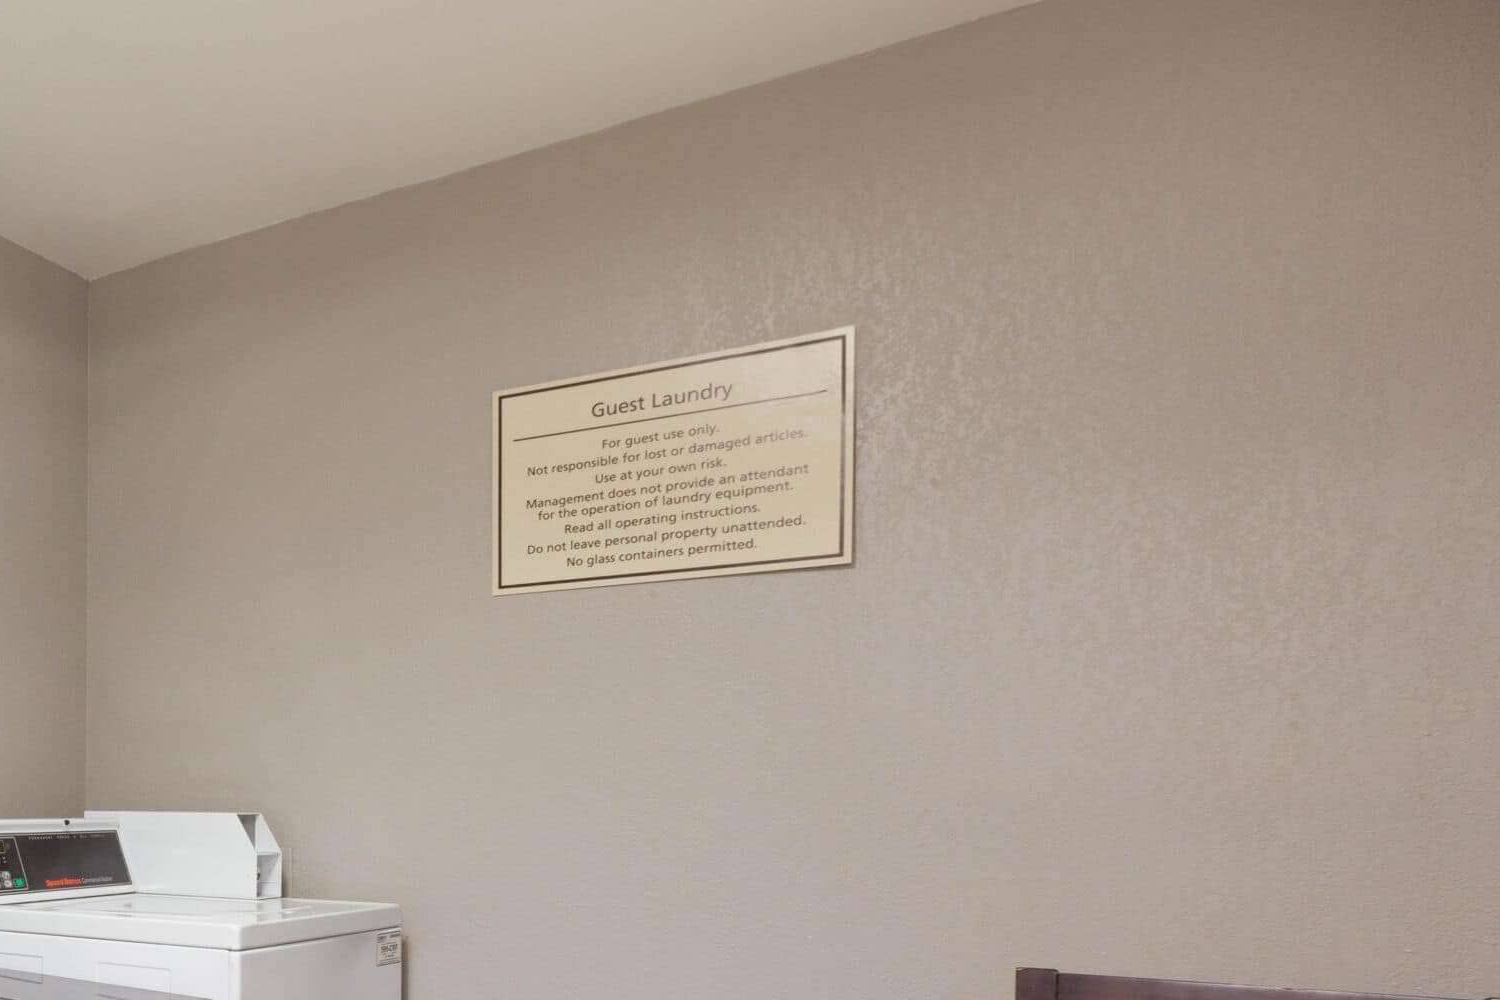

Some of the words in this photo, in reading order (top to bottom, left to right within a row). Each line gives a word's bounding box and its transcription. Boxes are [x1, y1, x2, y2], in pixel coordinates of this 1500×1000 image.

[591, 396, 645, 418] Guest
[651, 382, 733, 409] Laundry
[527, 466, 549, 477] Not
[551, 455, 619, 473] responsible
[622, 452, 641, 463] for
[644, 448, 667, 460] lost
[670, 447, 685, 457] or
[688, 434, 751, 454] damaged
[754, 428, 809, 445] articles.
[602, 439, 623, 449] For
[624, 432, 660, 449] guest
[663, 430, 685, 441] use
[687, 423, 720, 437] only.
[526, 490, 605, 509] Management
[607, 487, 637, 499] does
[640, 483, 662, 496] not
[665, 475, 716, 494] provide
[718, 475, 736, 486] an
[739, 464, 809, 482] attendant
[595, 473, 617, 484] Use
[619, 470, 633, 481] at
[635, 466, 665, 481] your
[667, 463, 697, 474] own
[700, 456, 727, 470] risk.
[537, 510, 556, 521] for
[557, 507, 578, 519] the
[580, 500, 641, 517] operation
[644, 495, 659, 508] of
[662, 491, 712, 506] laundry
[715, 481, 794, 500] equipment.
[564, 521, 594, 534] Read
[597, 519, 612, 531] all
[614, 513, 677, 530] operating
[681, 504, 761, 521] instructions.
[527, 545, 544, 555] Do
[546, 542, 567, 553] not
[570, 539, 602, 551] leave
[604, 530, 658, 549] personal
[661, 525, 718, 543] property
[721, 514, 806, 534] unattended.
[566, 556, 584, 567] No
[586, 552, 616, 567] glass
[618, 547, 685, 562] containers
[687, 537, 757, 557] permitted.
